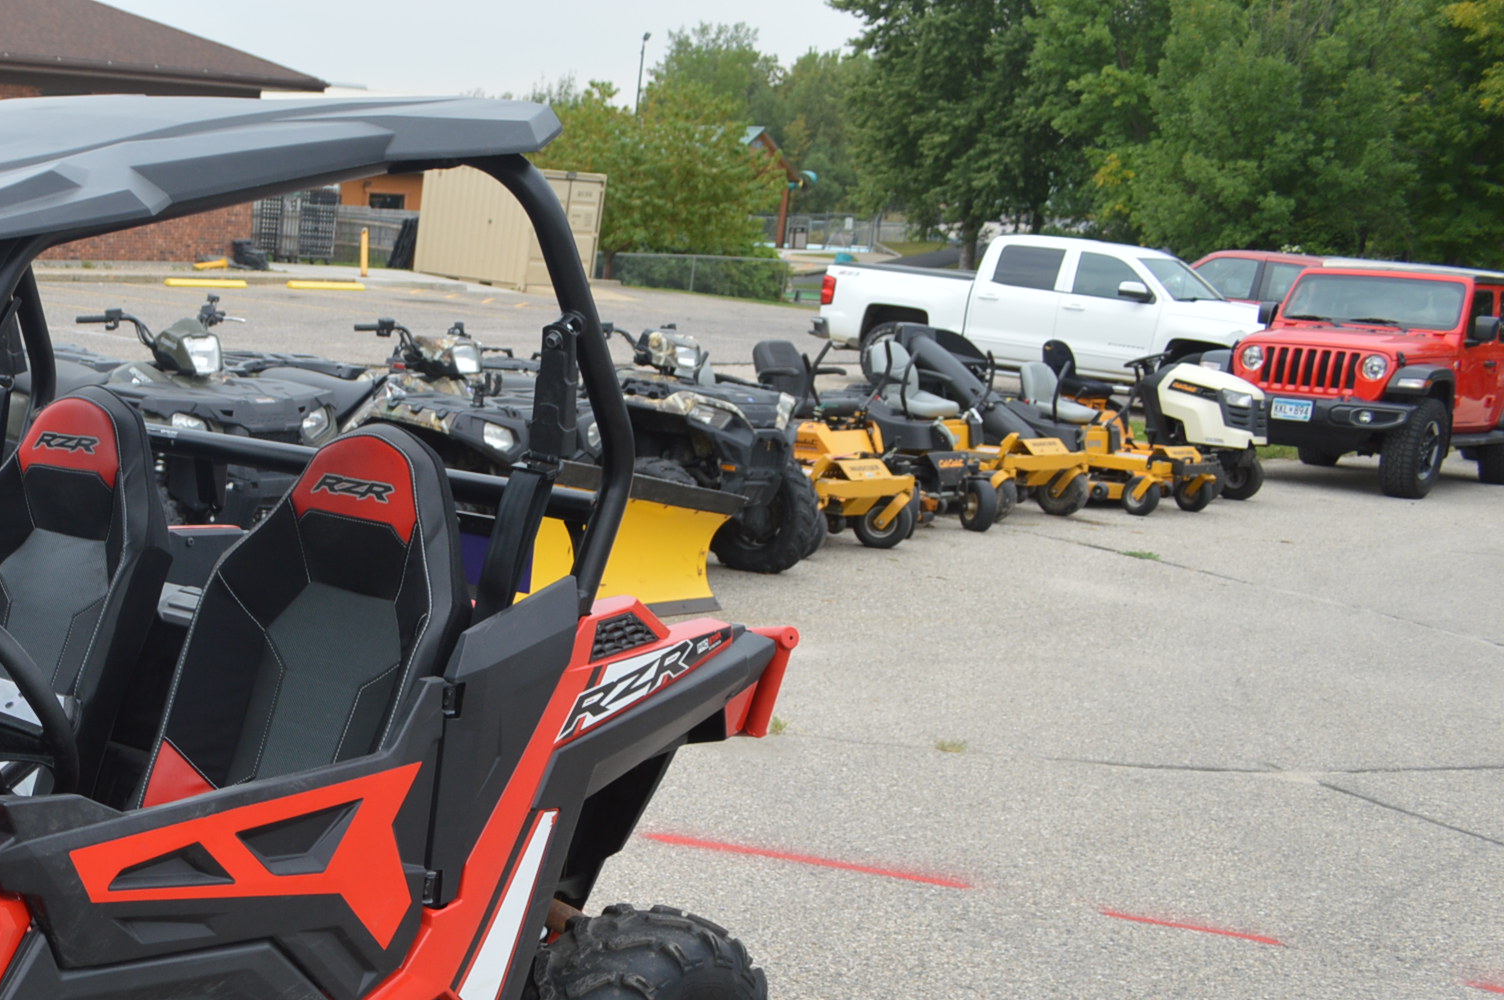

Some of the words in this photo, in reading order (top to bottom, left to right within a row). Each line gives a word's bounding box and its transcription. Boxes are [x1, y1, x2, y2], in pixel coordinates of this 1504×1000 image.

[32, 431, 100, 455] RZR
[310, 472, 396, 504] RZR
[553, 638, 694, 744] RZR
